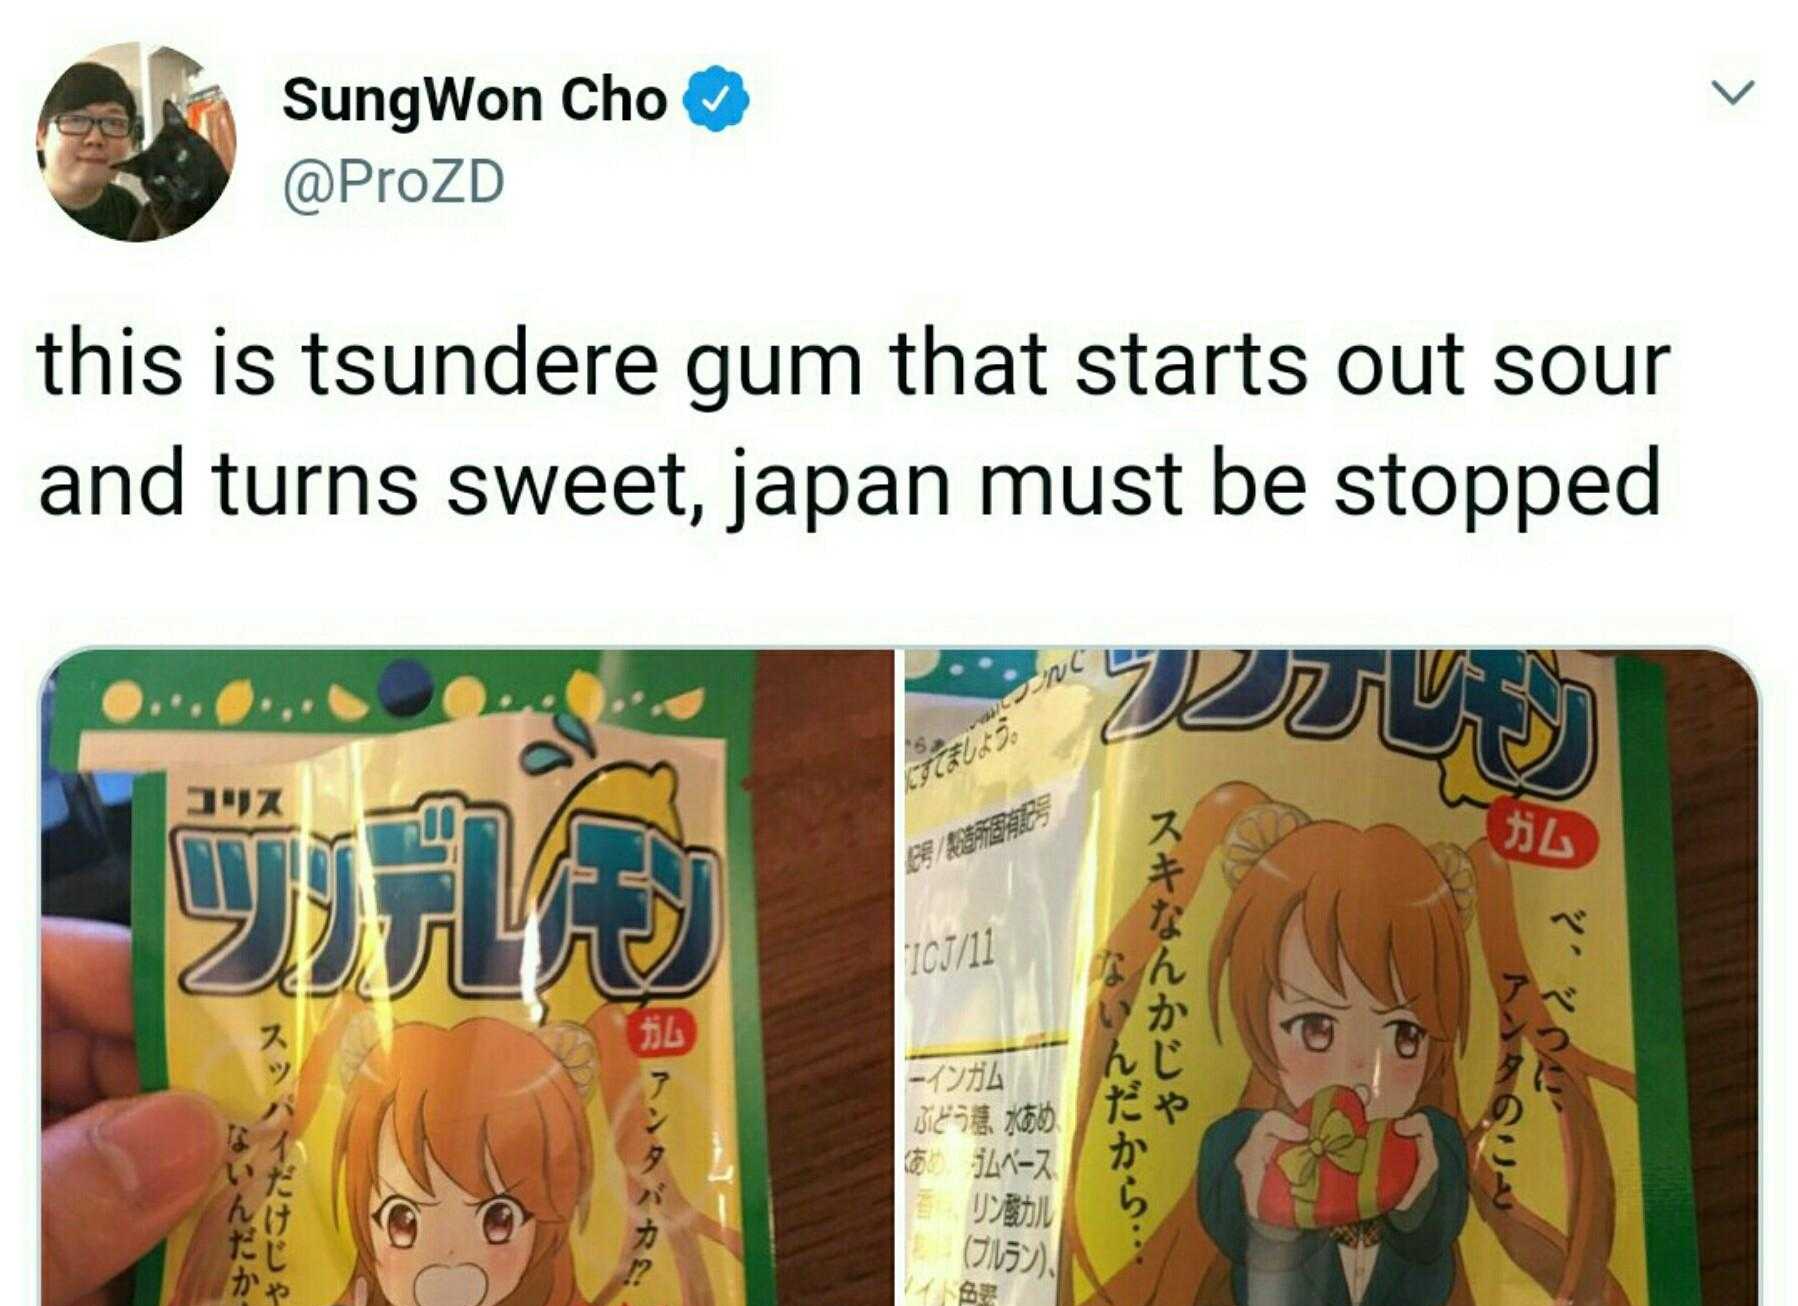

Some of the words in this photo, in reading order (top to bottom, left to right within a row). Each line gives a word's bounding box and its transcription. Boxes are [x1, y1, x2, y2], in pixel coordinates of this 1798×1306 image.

[187, 786, 283, 816] コリス
[1503, 811, 1575, 859] ガム
[172, 793, 722, 998] ツンデレモン
[1148, 809, 1190, 1125] スキなんかじゃ
[640, 1016, 686, 1050] ガム
[1491, 973, 1530, 1211] アンタのこと
